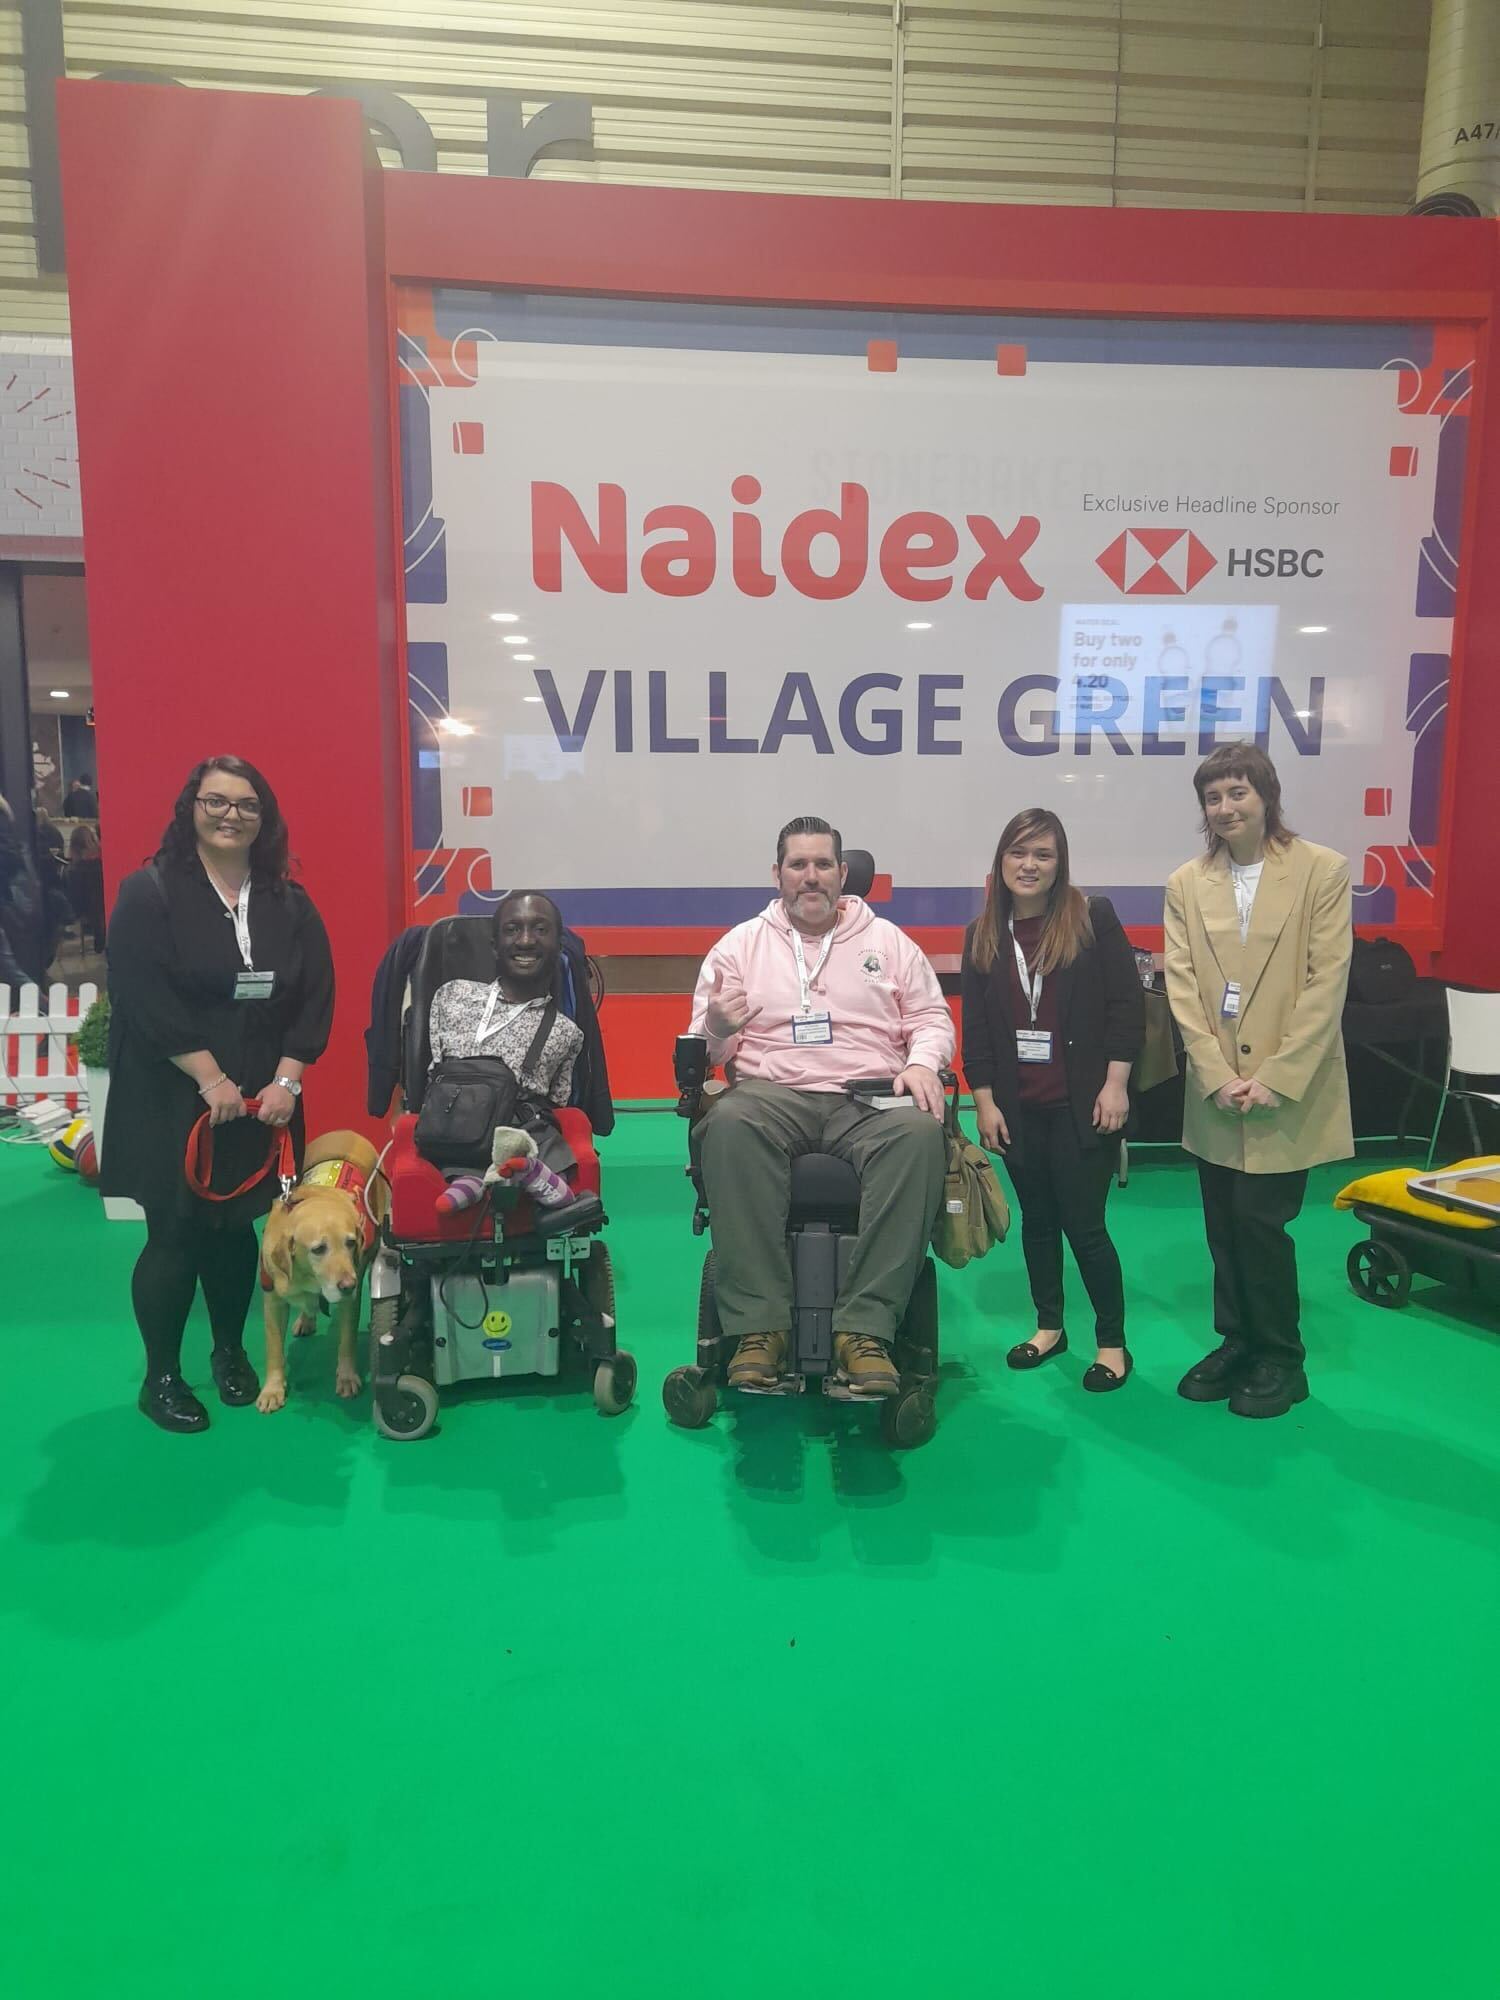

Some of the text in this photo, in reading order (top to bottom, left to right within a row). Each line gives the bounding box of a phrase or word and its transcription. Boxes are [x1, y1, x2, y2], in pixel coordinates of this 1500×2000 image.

[1083, 493, 1341, 518] Exclusive Headline Sponsor
[531, 474, 1044, 601] Naidex
[1227, 548, 1325, 578] HSBC
[1074, 632, 1142, 650] Buy two
[1073, 653, 1137, 671] for only
[533, 669, 1326, 757] VILLAGE GREEN
